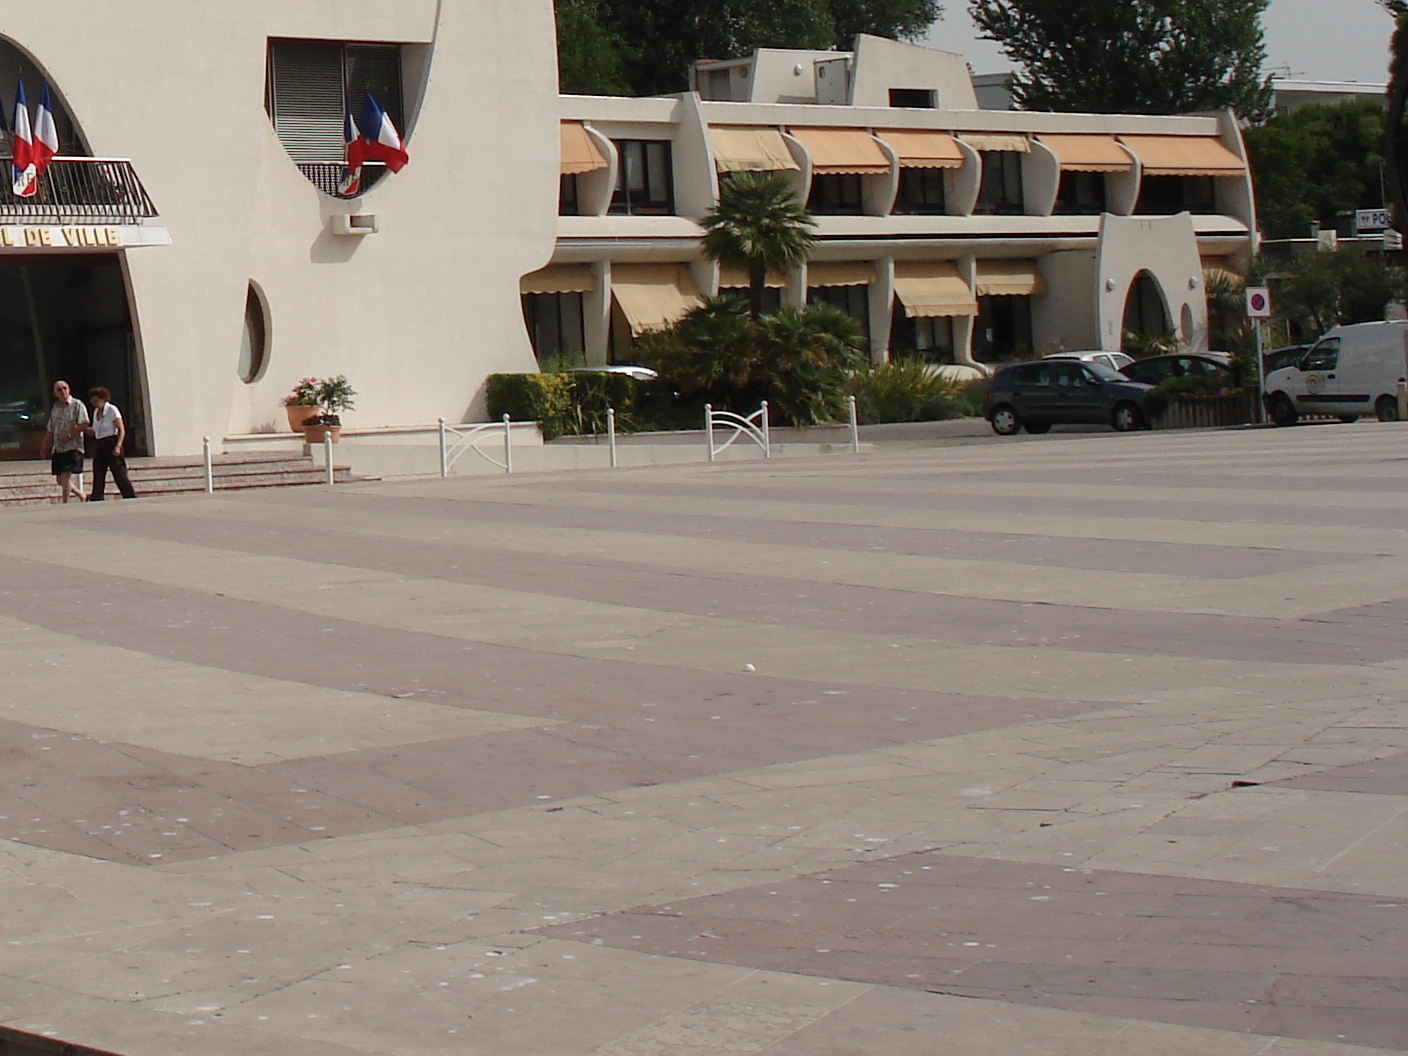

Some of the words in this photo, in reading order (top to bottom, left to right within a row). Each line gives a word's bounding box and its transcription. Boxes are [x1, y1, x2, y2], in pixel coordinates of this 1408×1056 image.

[17, 172, 34, 187] RF
[23, 228, 52, 246] DE
[60, 227, 119, 246] VILLE
